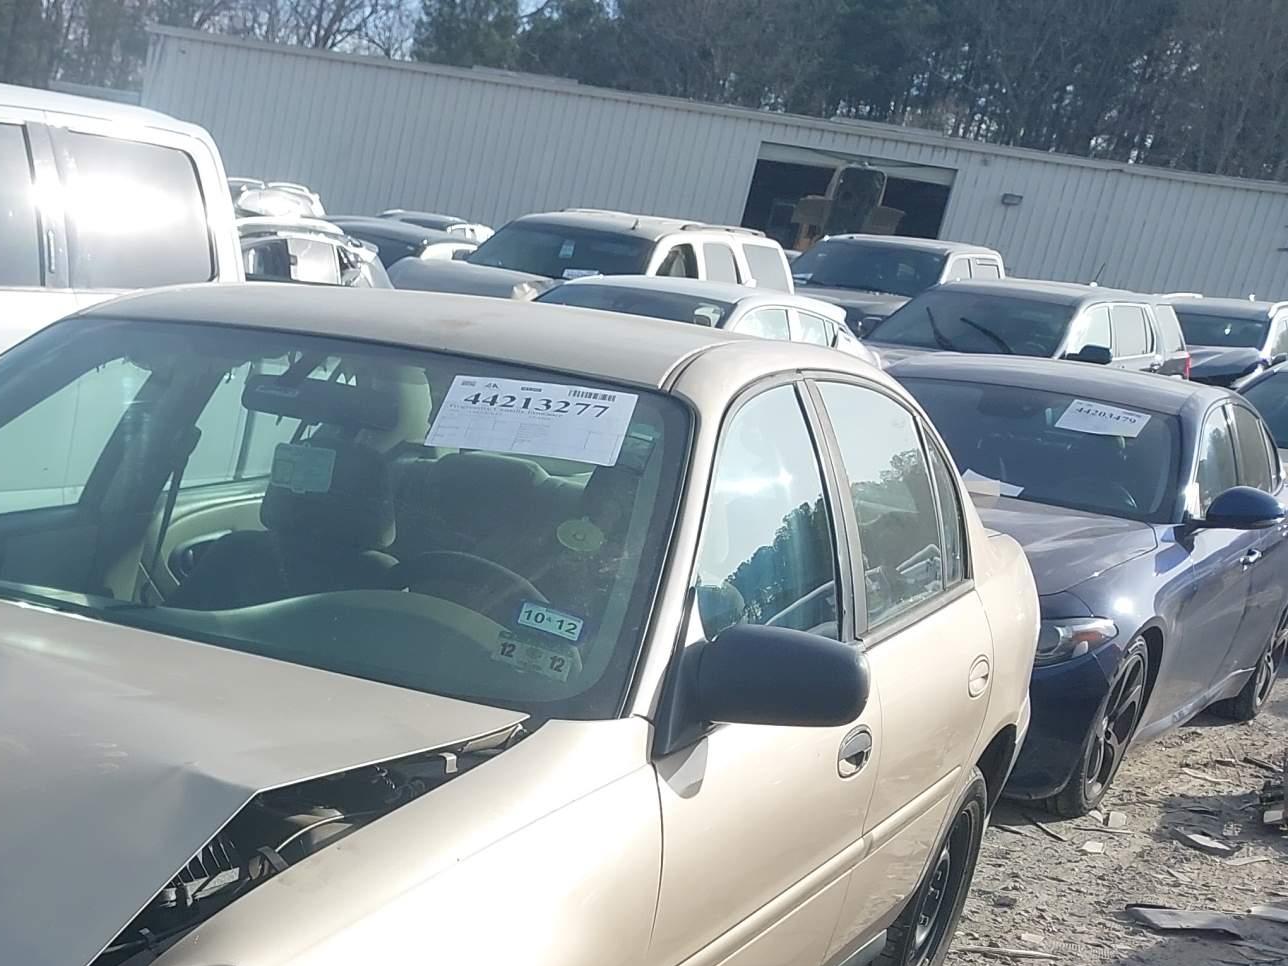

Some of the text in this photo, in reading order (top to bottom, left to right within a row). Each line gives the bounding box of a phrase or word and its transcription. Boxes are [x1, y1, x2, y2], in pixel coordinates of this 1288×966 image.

[464, 392, 610, 418] 44213277
[500, 641, 517, 658] 12
[549, 655, 566, 673] 12
